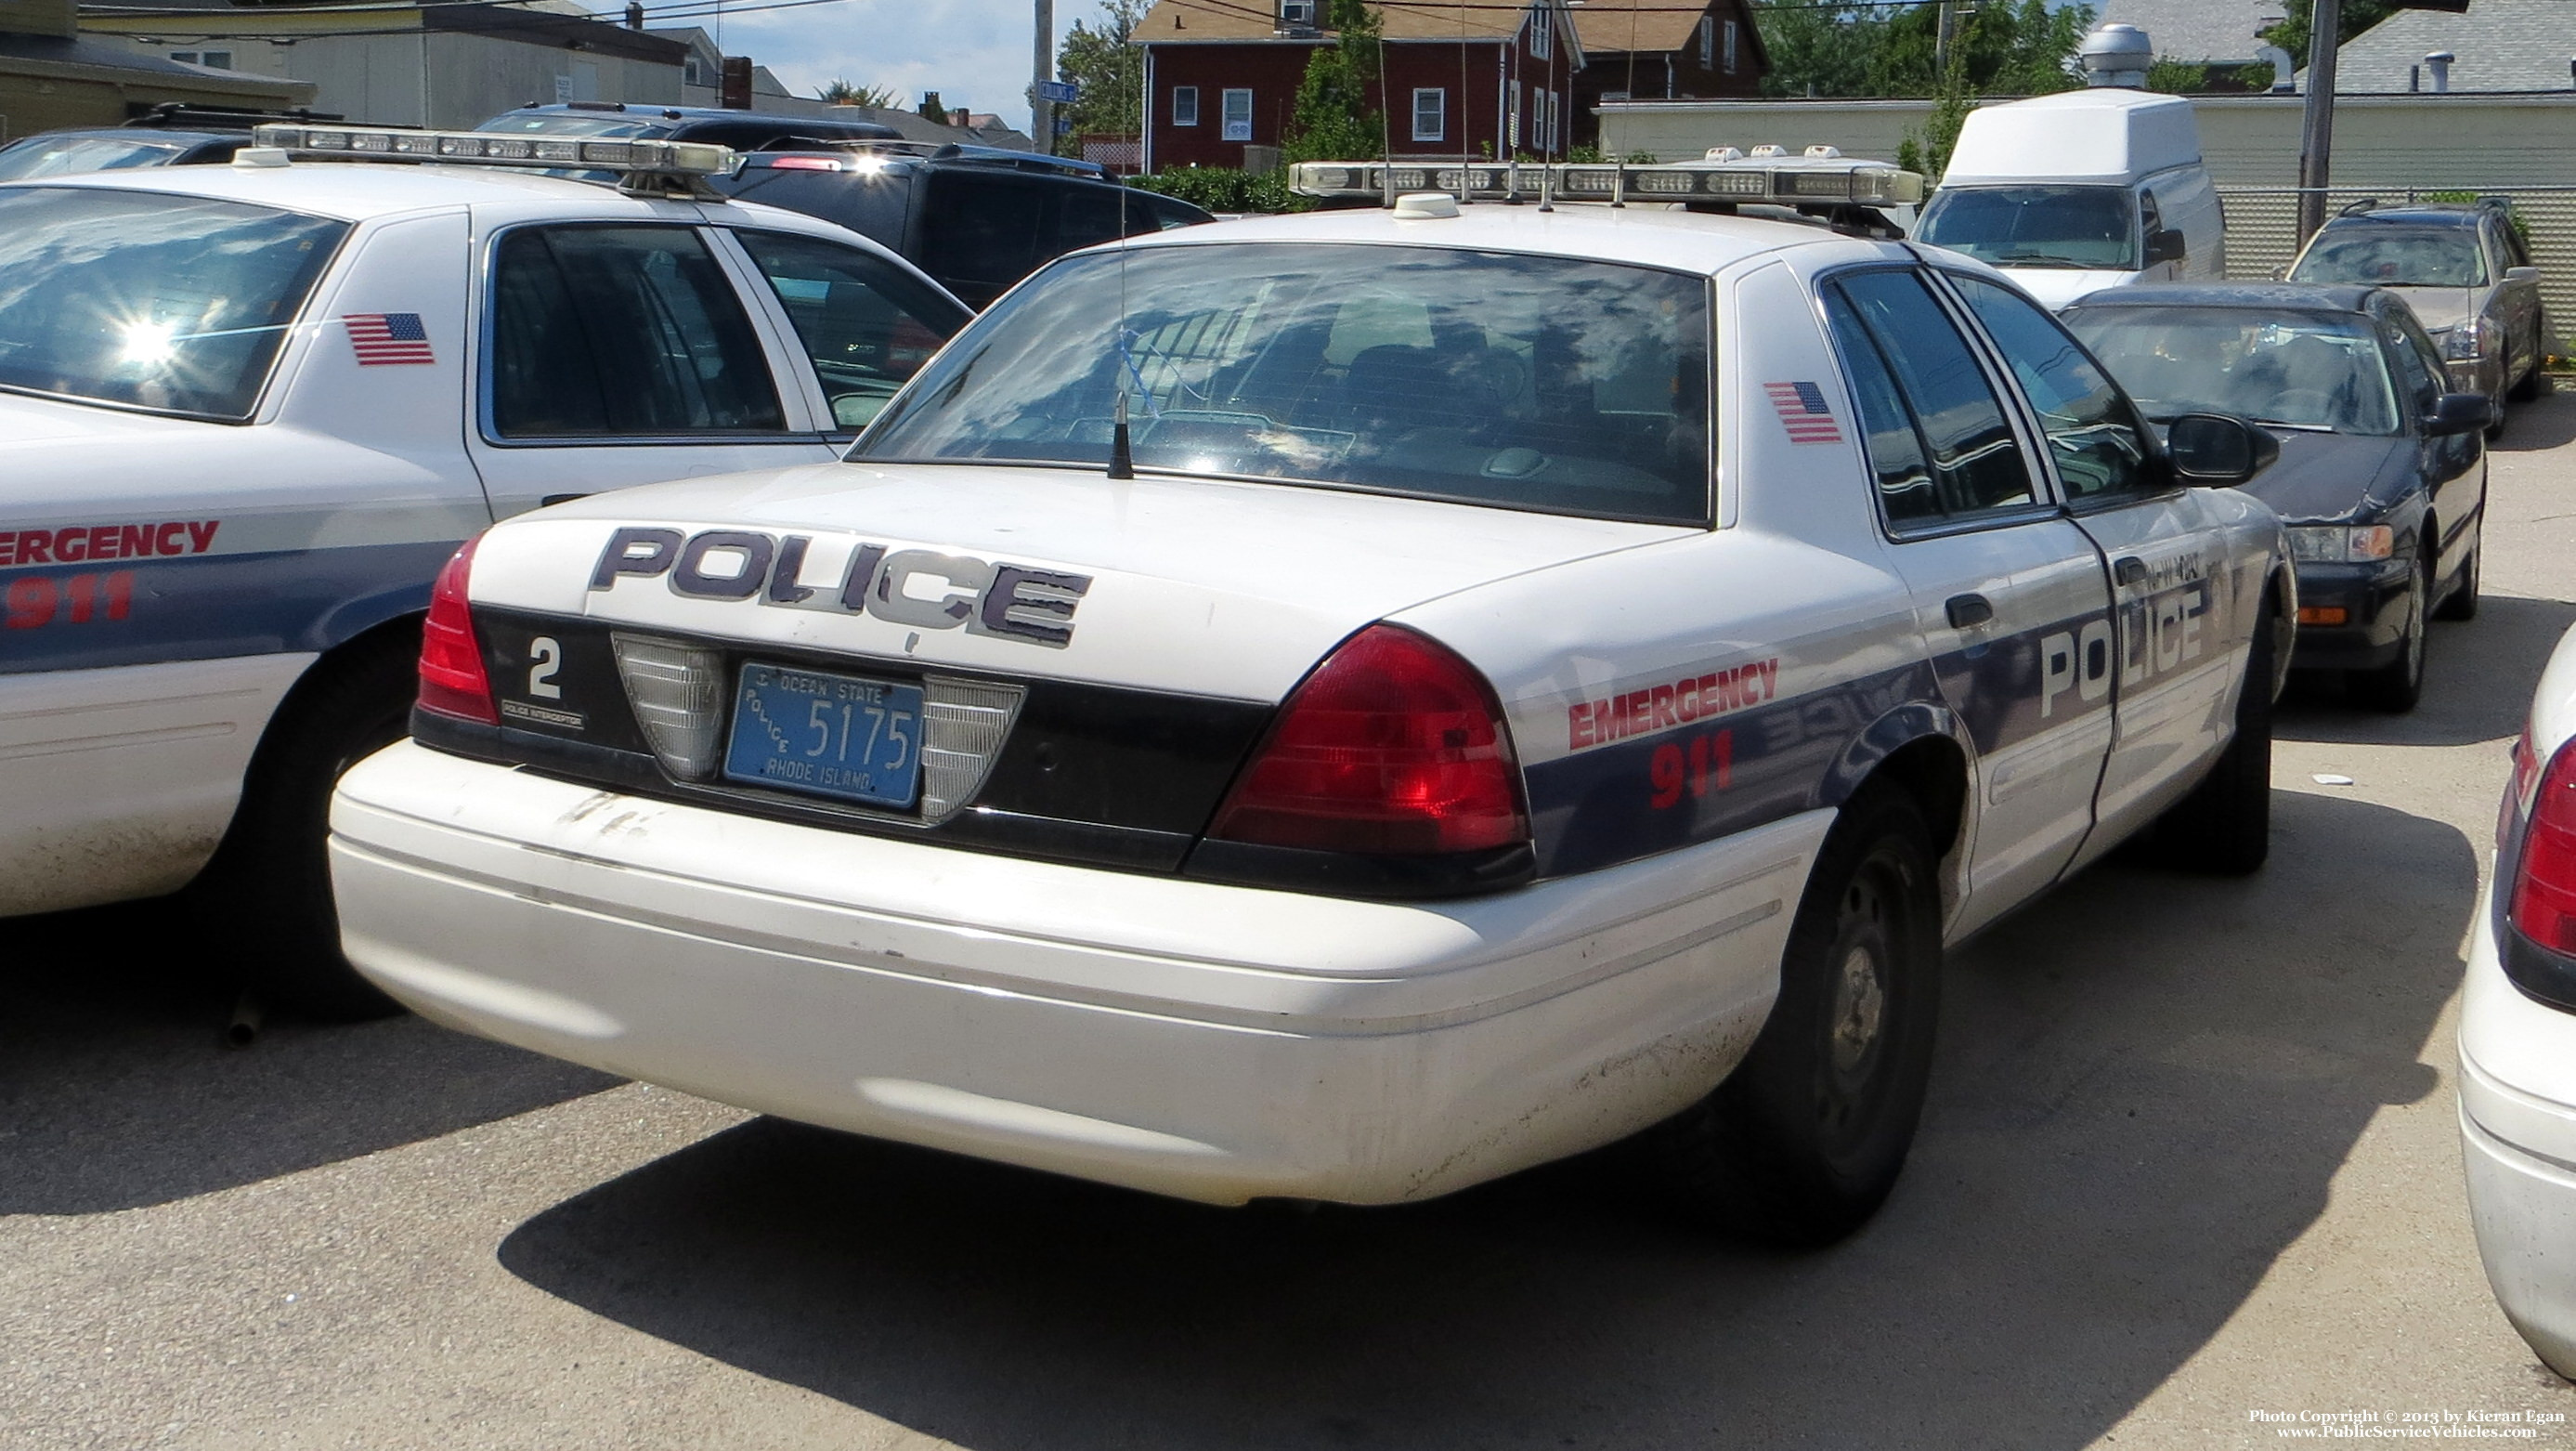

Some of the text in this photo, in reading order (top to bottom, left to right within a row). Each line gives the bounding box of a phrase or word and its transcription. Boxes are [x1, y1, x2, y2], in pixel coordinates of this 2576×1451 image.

[6, 569, 136, 631] 911
[589, 527, 1095, 647] POLICE
[530, 636, 561, 699] 2
[2041, 588, 2201, 719] POLICE
[746, 688, 788, 753] POLICE
[780, 674, 883, 704] OCEAN STATE
[1568, 658, 1778, 751] EMERGENCY
[806, 699, 912, 770] 5175
[767, 757, 871, 790] RHODE ISLAND
[1650, 729, 1734, 809] 911
